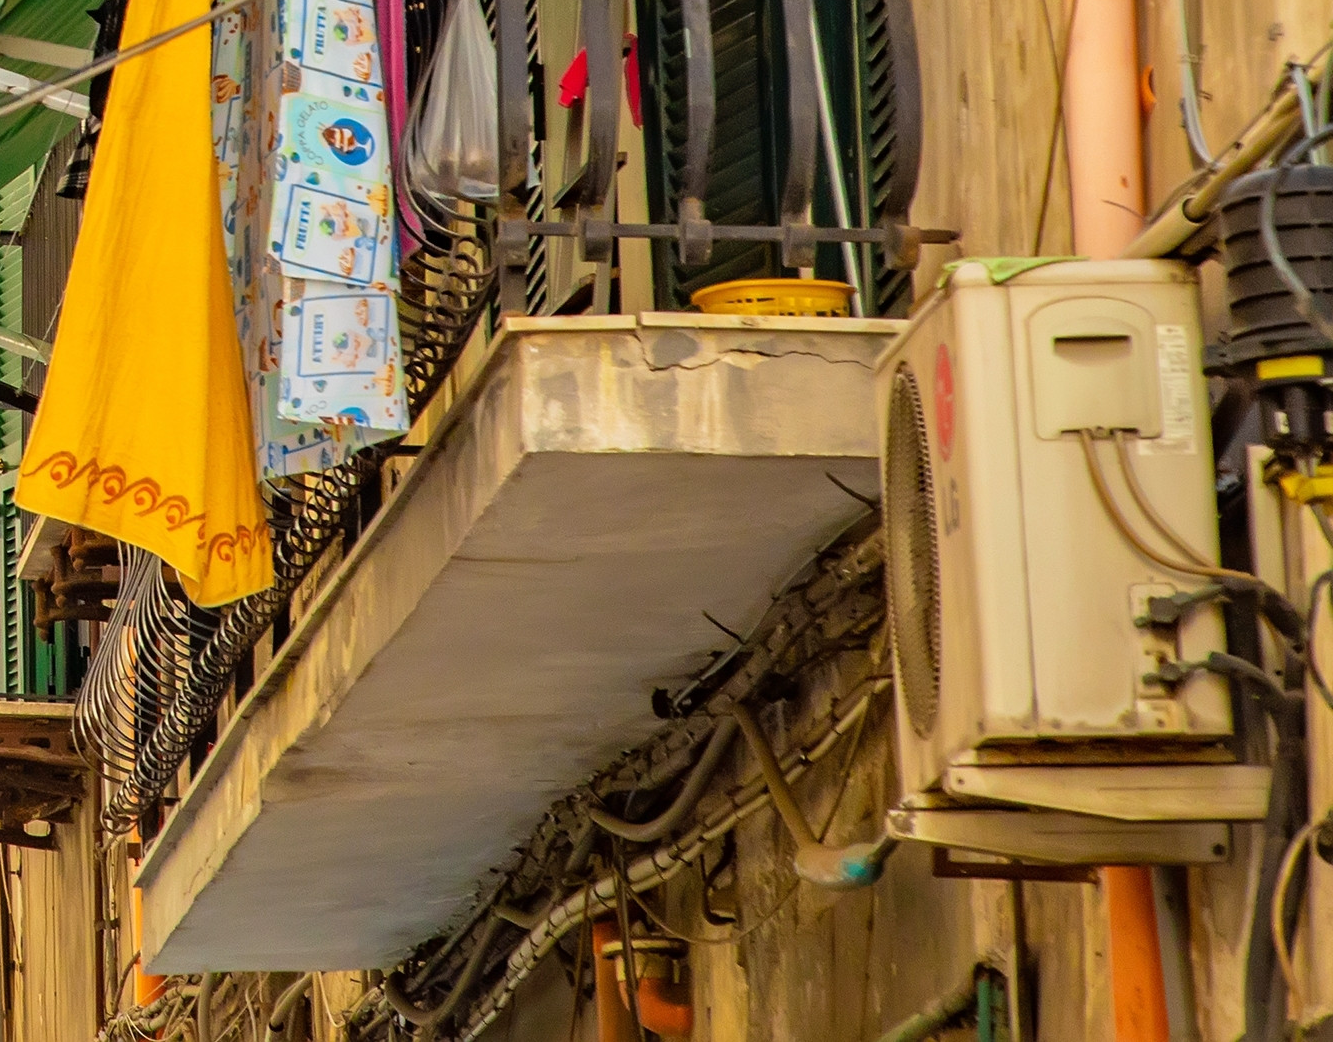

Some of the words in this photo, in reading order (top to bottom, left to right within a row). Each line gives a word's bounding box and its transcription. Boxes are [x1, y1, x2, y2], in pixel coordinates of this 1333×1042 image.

[315, 7, 326, 55] FRUTTA
[297, 101, 328, 128] GELATO
[298, 131, 324, 165] COPPA
[295, 202, 311, 250] FRUTTA
